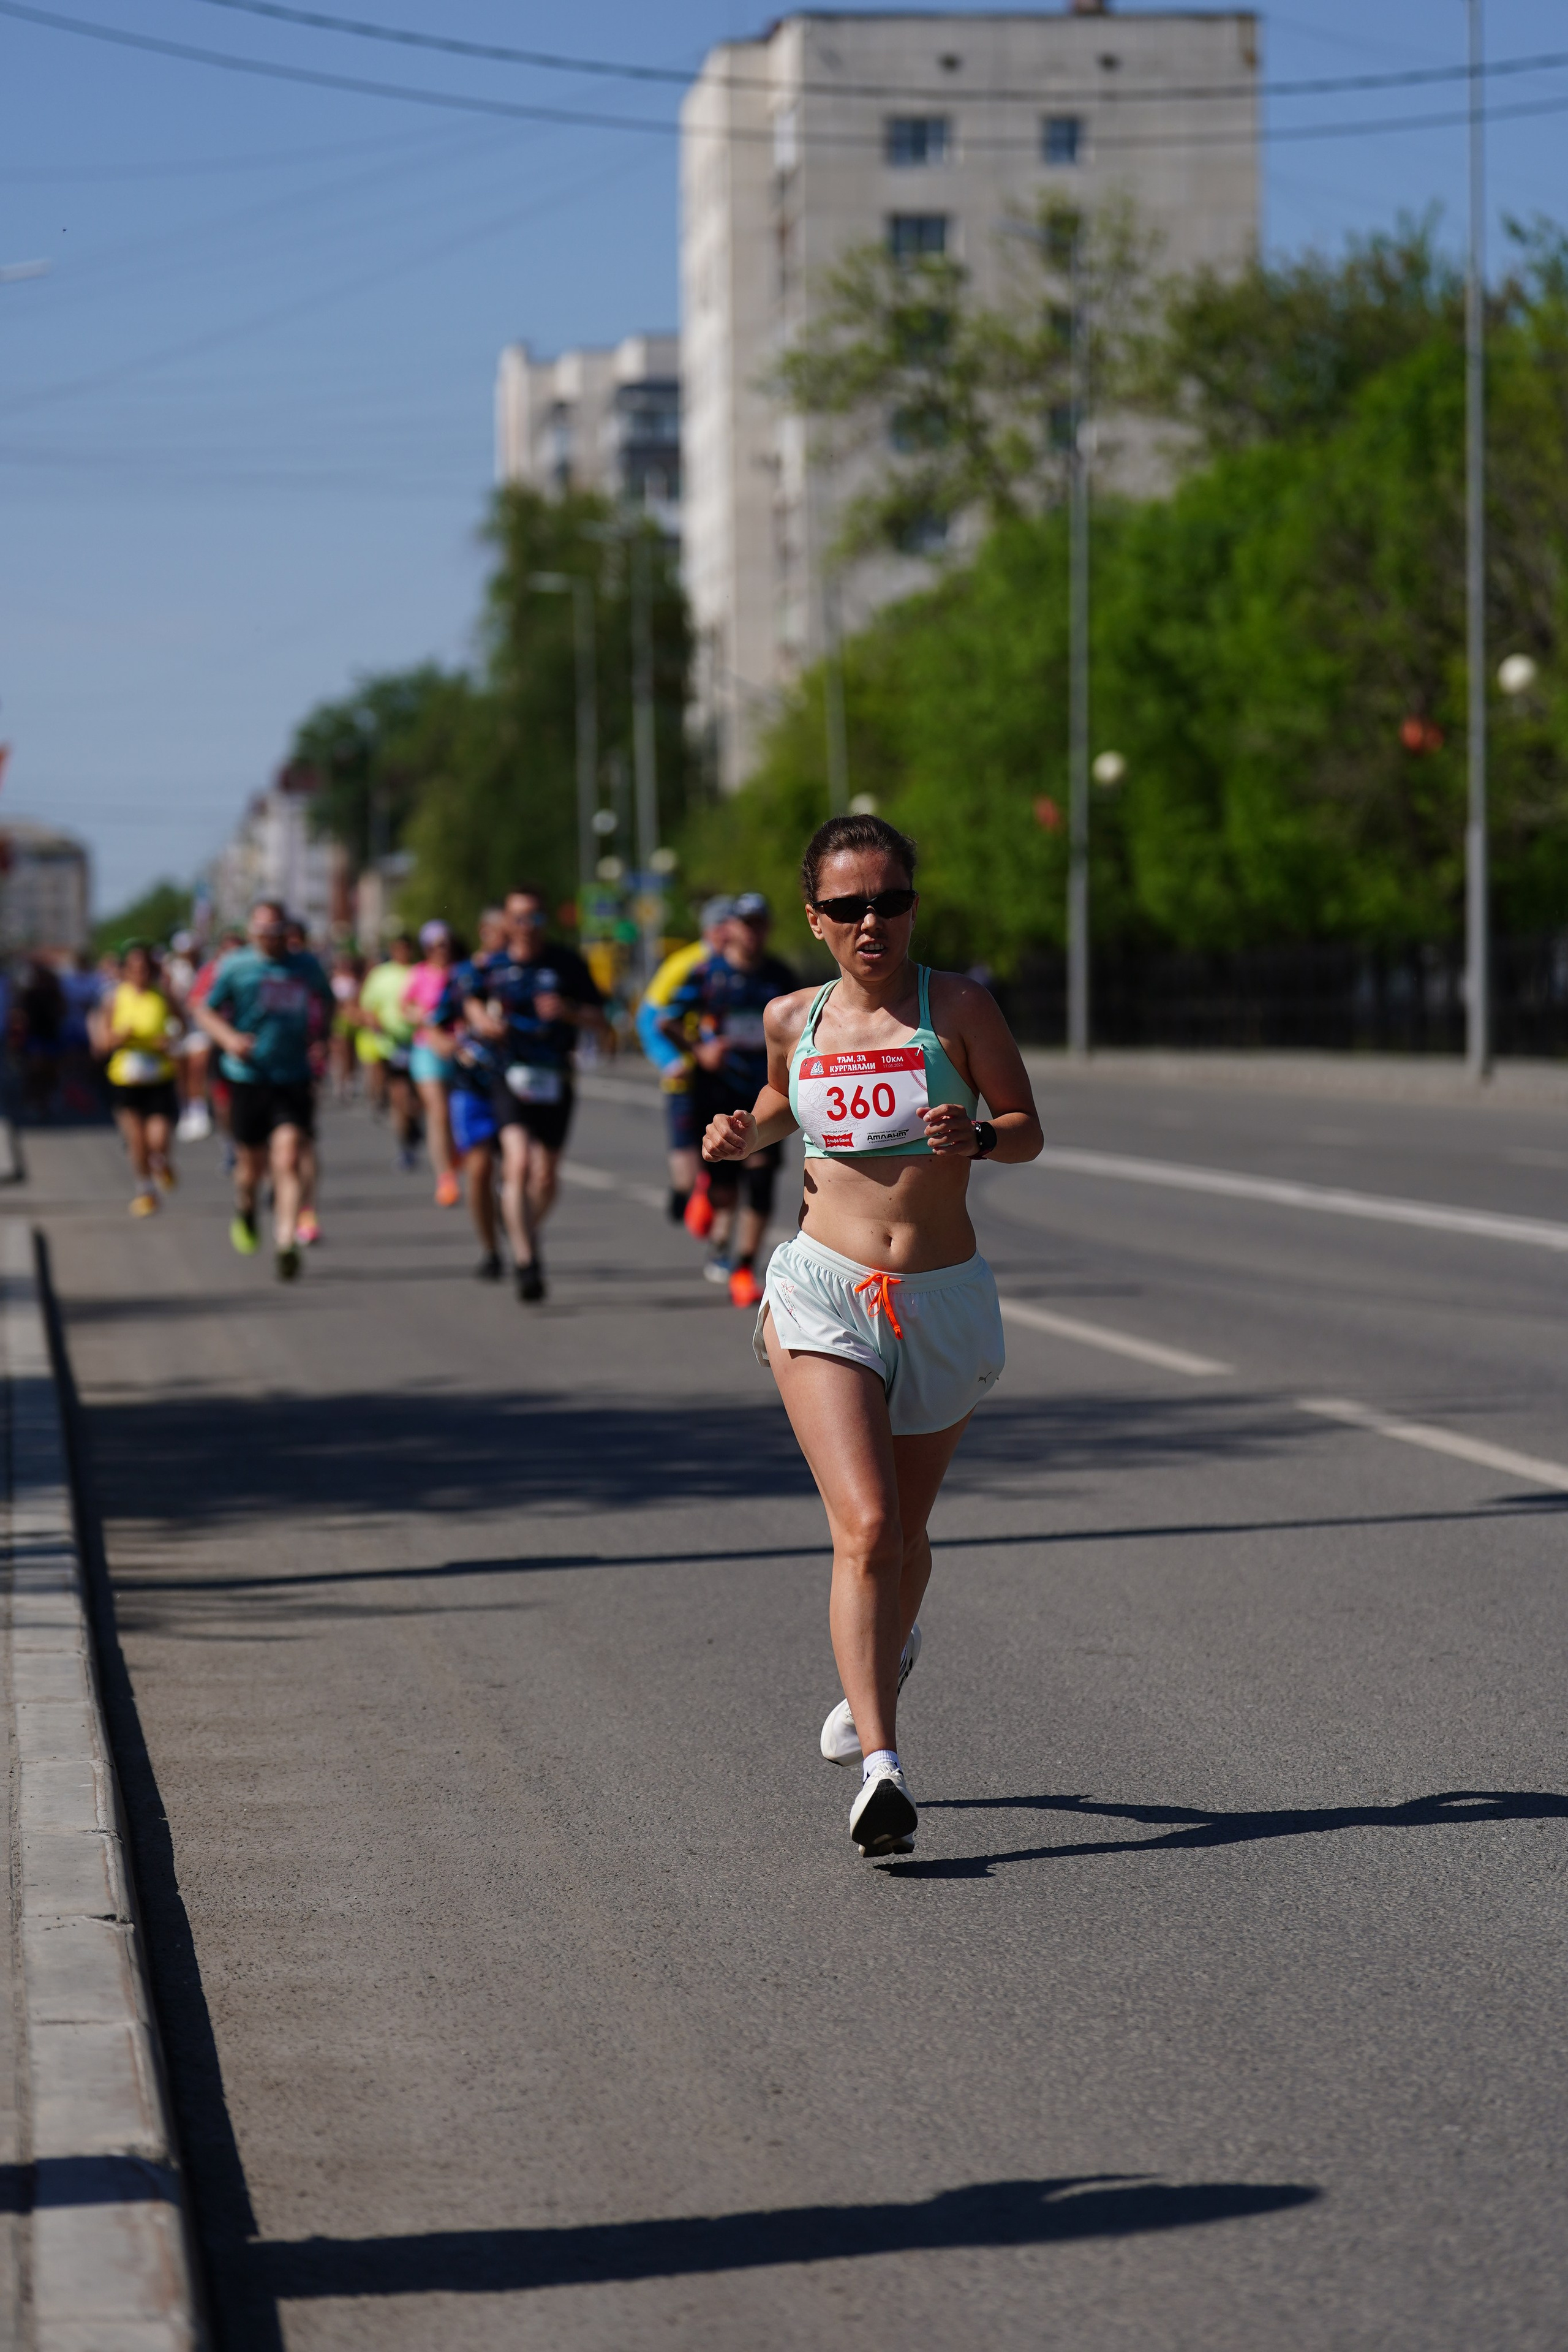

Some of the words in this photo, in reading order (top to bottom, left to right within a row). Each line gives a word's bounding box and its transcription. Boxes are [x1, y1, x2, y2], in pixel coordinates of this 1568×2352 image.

[837, 1055, 856, 1064] ТАМ,
[829, 1063, 876, 1073] КУРГАНАМИ
[826, 1083, 895, 1121] 360
